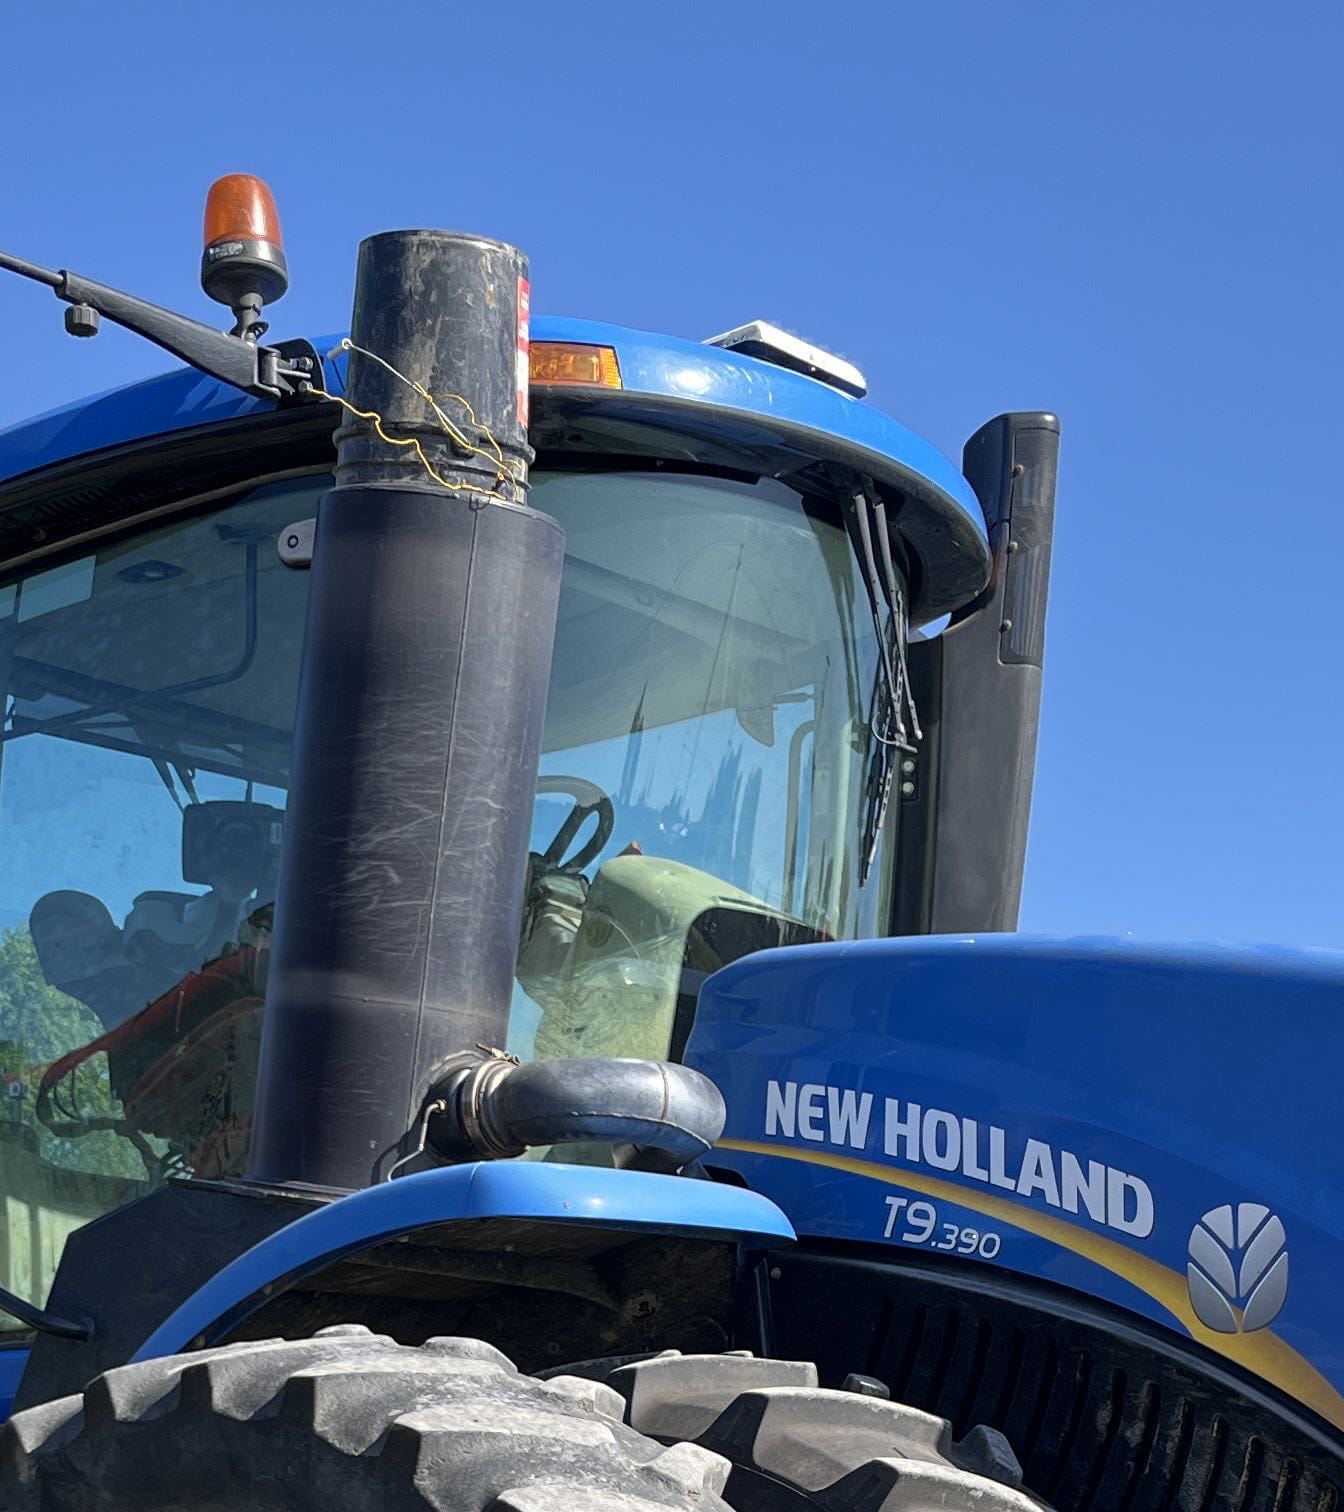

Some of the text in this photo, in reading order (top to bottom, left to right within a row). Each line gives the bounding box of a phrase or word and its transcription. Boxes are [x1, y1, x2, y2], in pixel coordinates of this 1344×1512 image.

[765, 1080, 1155, 1239] NEW HOLLAND
[884, 1195, 1001, 1258] T9.390
